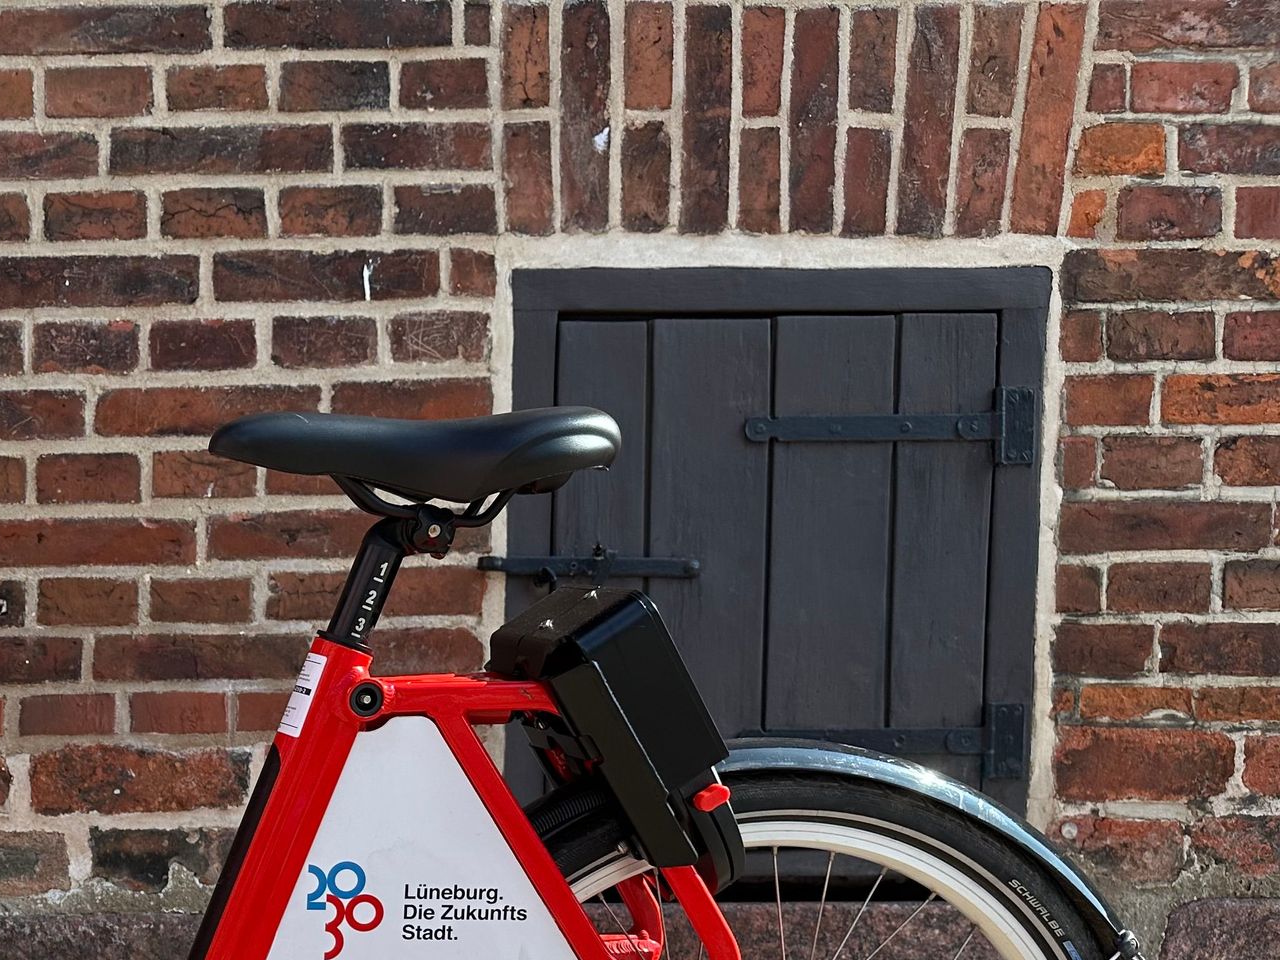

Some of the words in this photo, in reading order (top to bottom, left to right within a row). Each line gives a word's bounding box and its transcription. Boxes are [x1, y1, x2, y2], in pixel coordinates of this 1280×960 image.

[380, 562, 389, 576] 1
[366, 591, 377, 605] 2
[355, 618, 366, 631] 3
[404, 884, 504, 904] Lüneburg.
[403, 904, 435, 920] Die
[441, 904, 528, 921] Zukunfts
[1008, 879, 1065, 937] SCHWALBE
[402, 924, 458, 941] Stadt.
